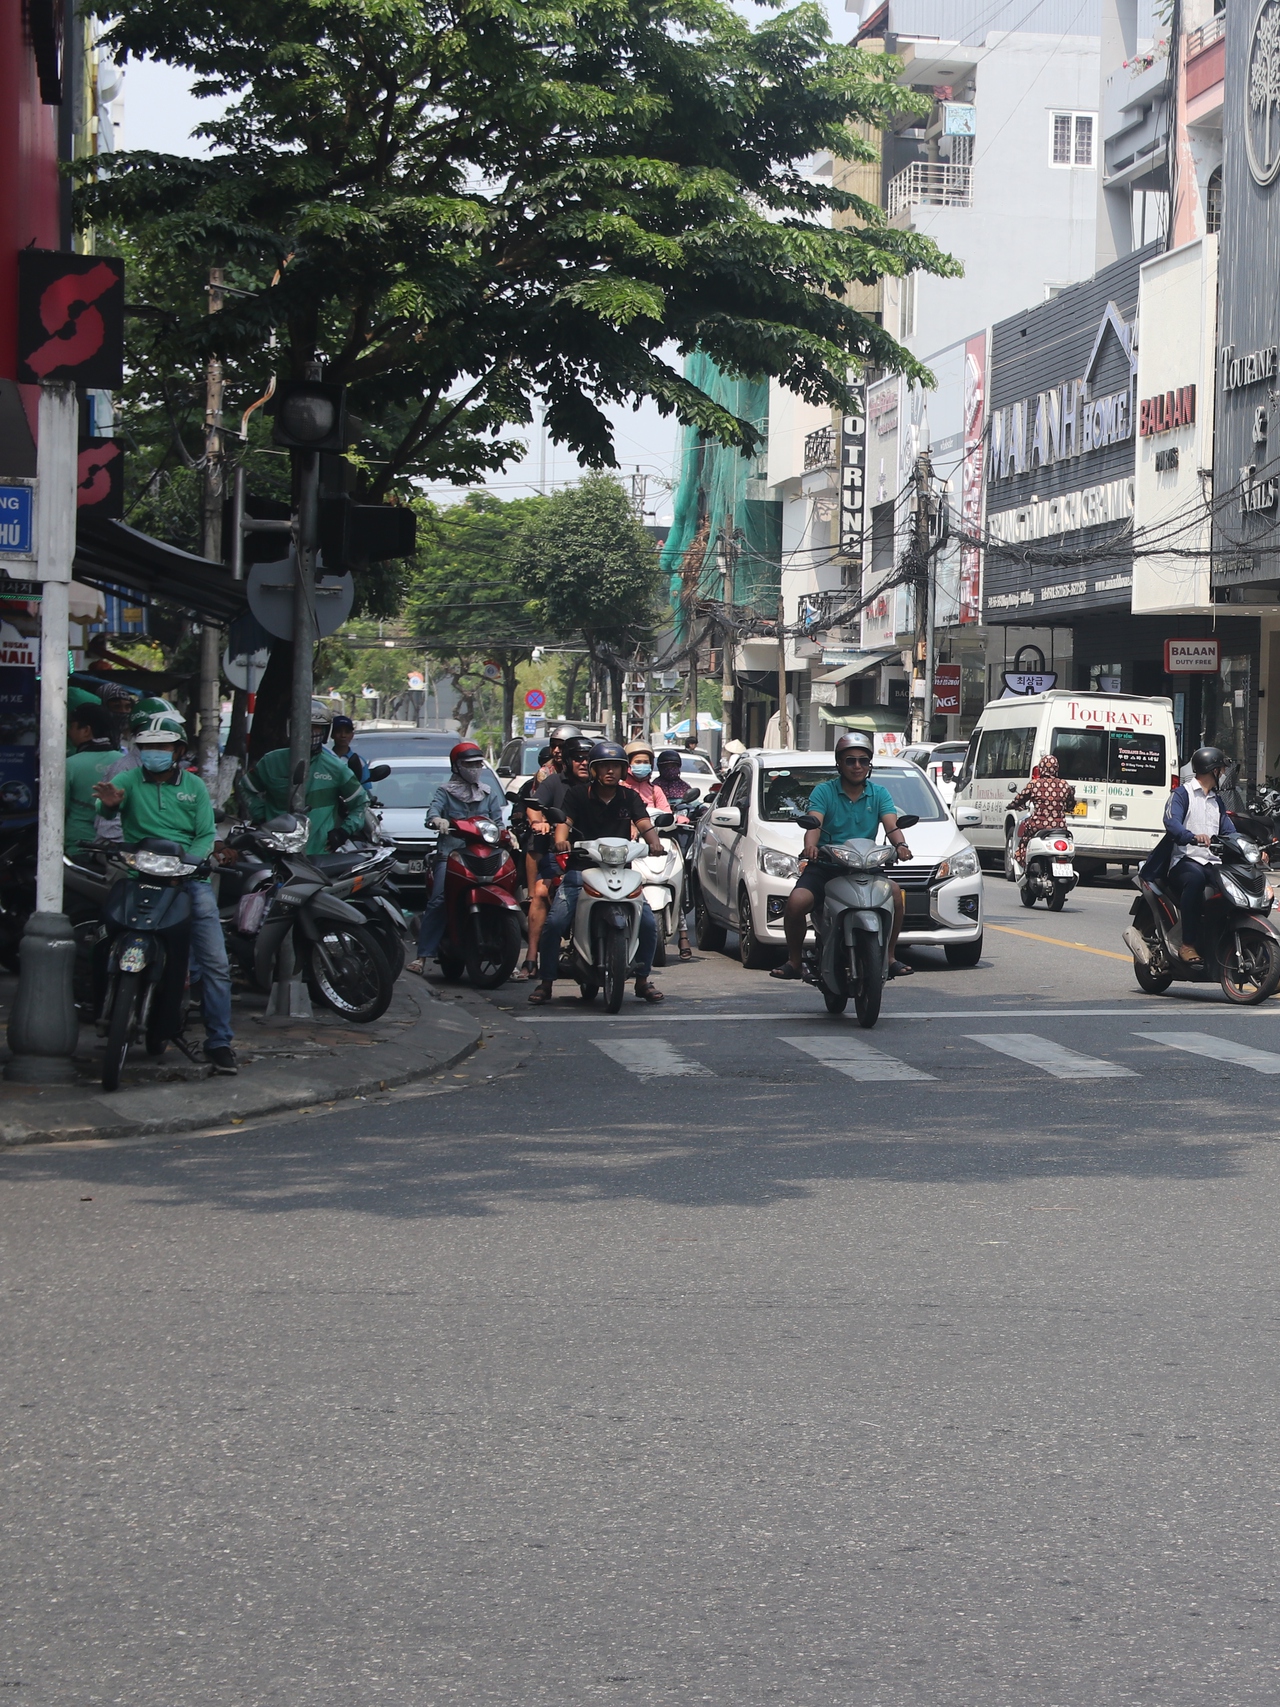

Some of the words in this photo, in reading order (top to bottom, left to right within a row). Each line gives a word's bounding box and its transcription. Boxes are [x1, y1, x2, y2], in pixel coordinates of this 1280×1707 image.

[1222, 344, 1277, 392] TOURANE
[1139, 384, 1196, 437] BALAAN
[1252, 405, 1268, 444] &
[988, 399, 1030, 483] MAI
[1031, 378, 1082, 468] ANH
[1239, 465, 1278, 513] NAILS
[1171, 646, 1216, 656] BALAAN
[1016, 676, 1044, 687] 최상급
[1067, 702, 1153, 726] TOURANE
[314, 772, 333, 781] Grab
[1083, 785, 1098, 794] 43F
[1108, 786, 1135, 797] 006.21
